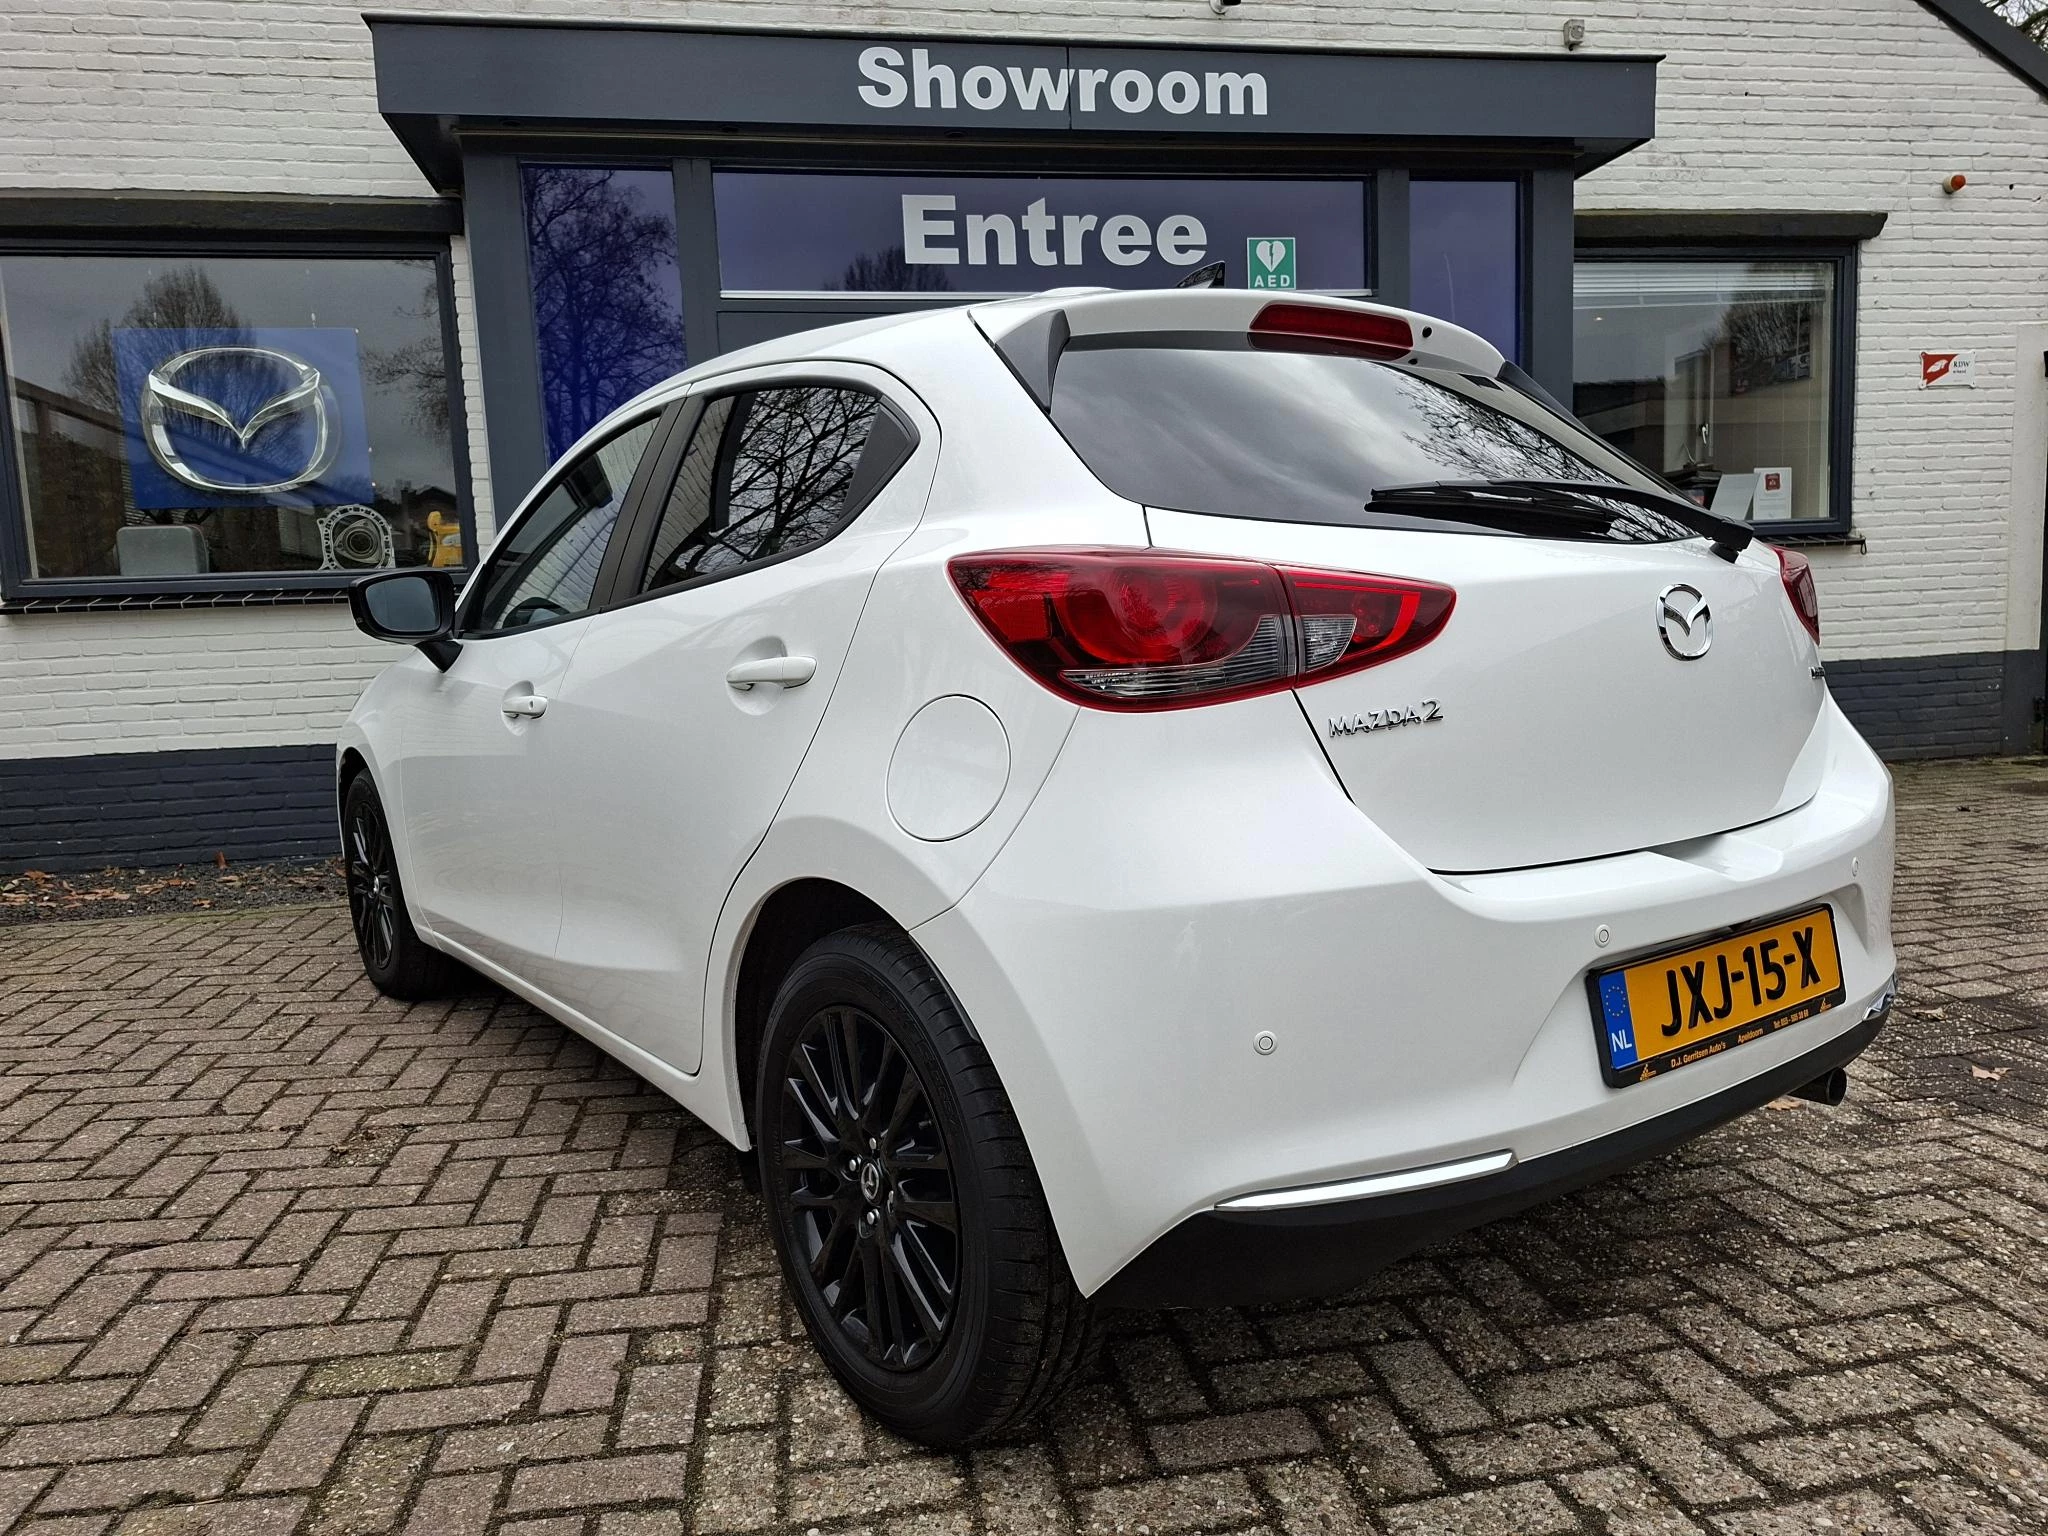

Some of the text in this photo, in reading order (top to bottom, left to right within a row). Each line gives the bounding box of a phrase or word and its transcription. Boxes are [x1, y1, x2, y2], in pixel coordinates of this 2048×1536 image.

[857, 46, 1269, 117] Showroom
[901, 194, 1208, 266] Entree
[1254, 274, 1291, 288] AED
[1953, 360, 1970, 368] RDW
[1660, 926, 1822, 1037] JXJ-15-X
[1611, 1029, 1633, 1052] NL
